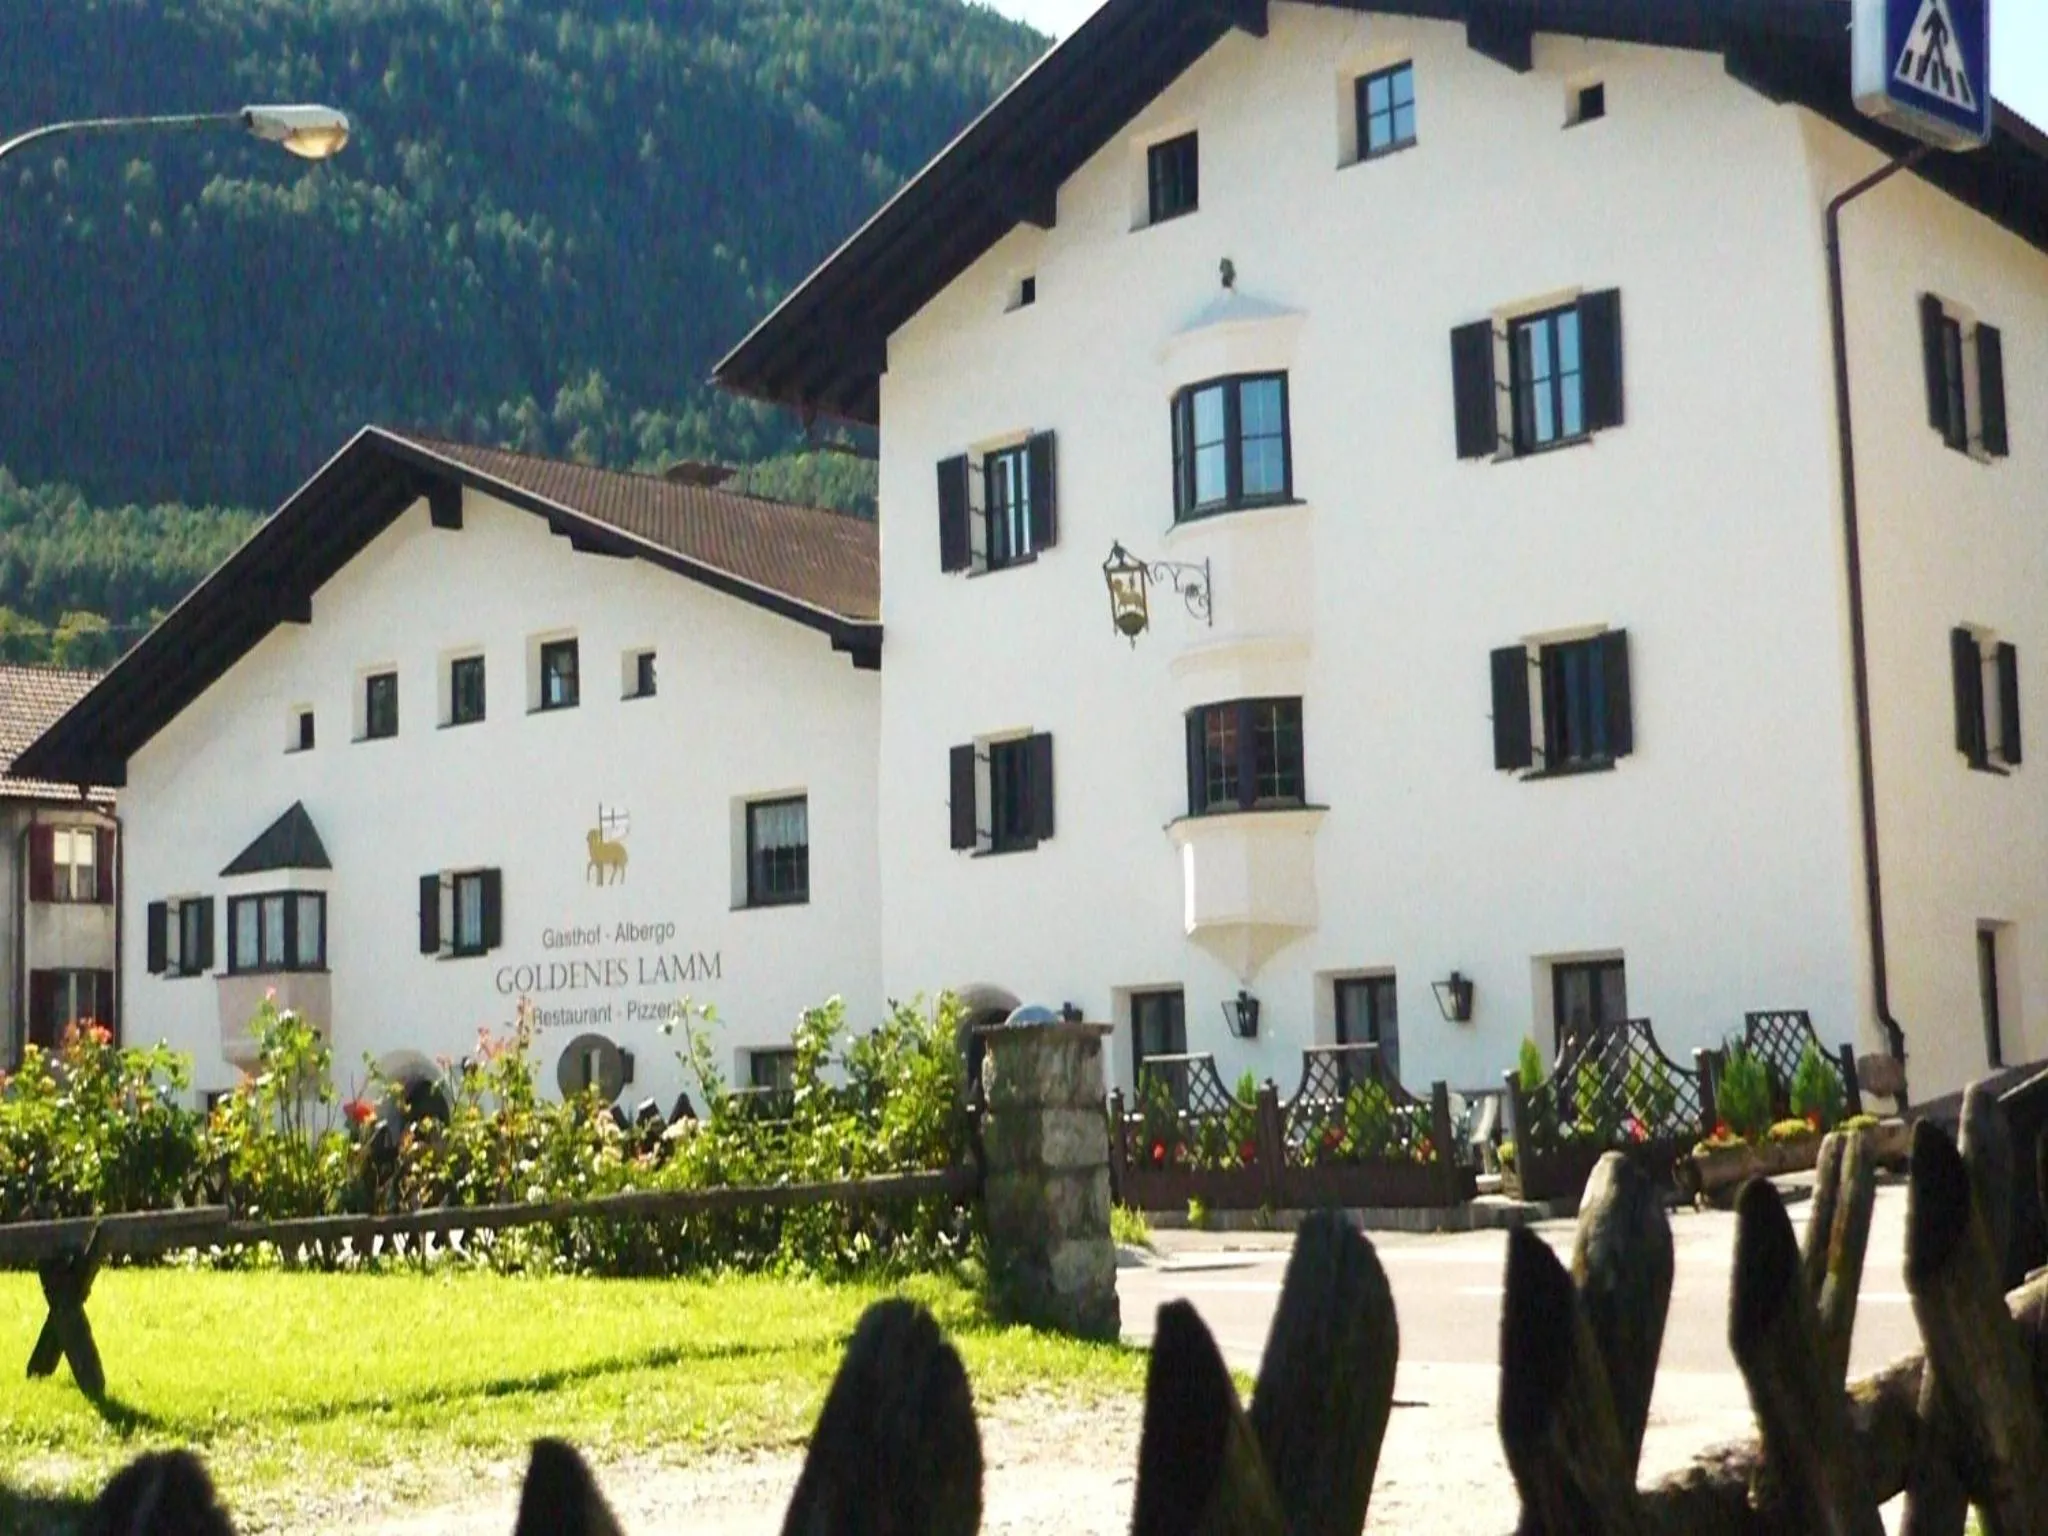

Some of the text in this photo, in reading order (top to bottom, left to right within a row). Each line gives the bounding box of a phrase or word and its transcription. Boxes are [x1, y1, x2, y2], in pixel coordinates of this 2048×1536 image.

[542, 921, 676, 949] Gasthof Albergo
[495, 951, 722, 994] GOLDENES LAMM
[532, 1003, 612, 1027] Restaurant
